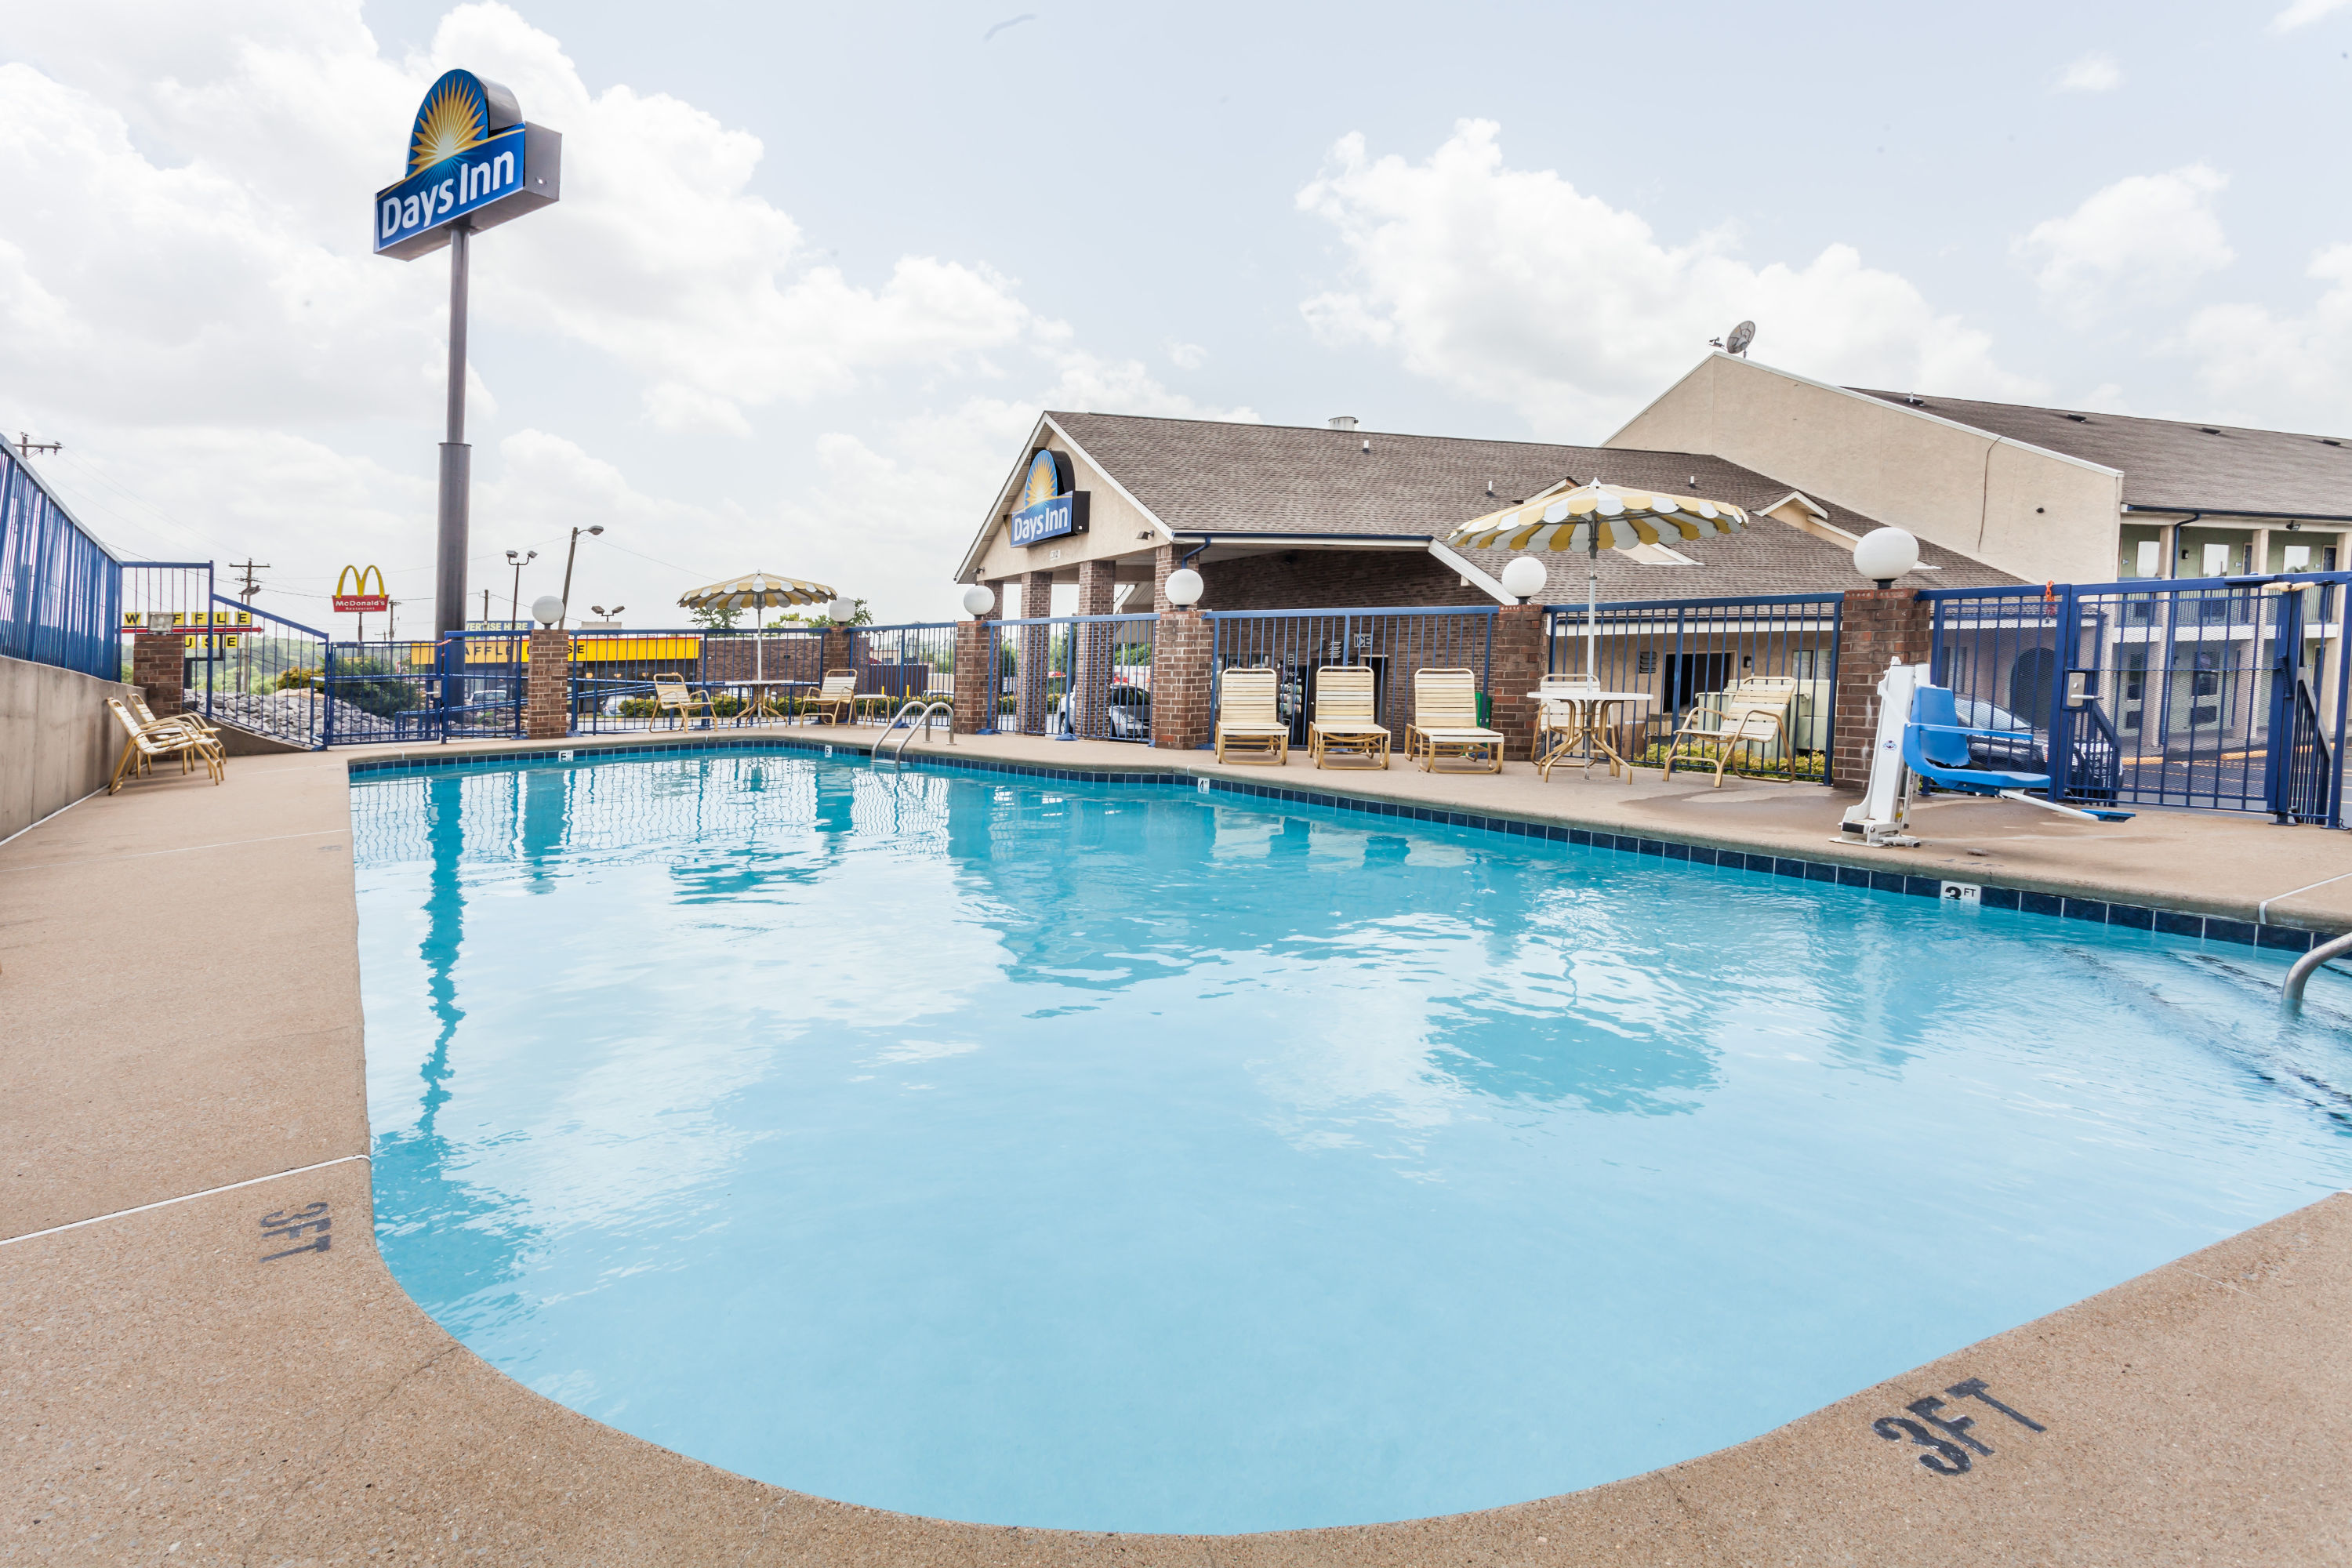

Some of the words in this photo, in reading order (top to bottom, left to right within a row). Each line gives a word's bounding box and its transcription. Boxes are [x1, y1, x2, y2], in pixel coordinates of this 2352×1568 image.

[383, 178, 454, 239] Days
[459, 151, 514, 205] Inn
[1014, 514, 1044, 542] Days
[1045, 506, 1069, 532] Inn
[125, 613, 247, 624] WFFLE
[1355, 636, 1371, 647] ICE
[1964, 887, 1976, 897] FT
[260, 1202, 331, 1263] 3FT
[1871, 1377, 2048, 1476] 3FT
